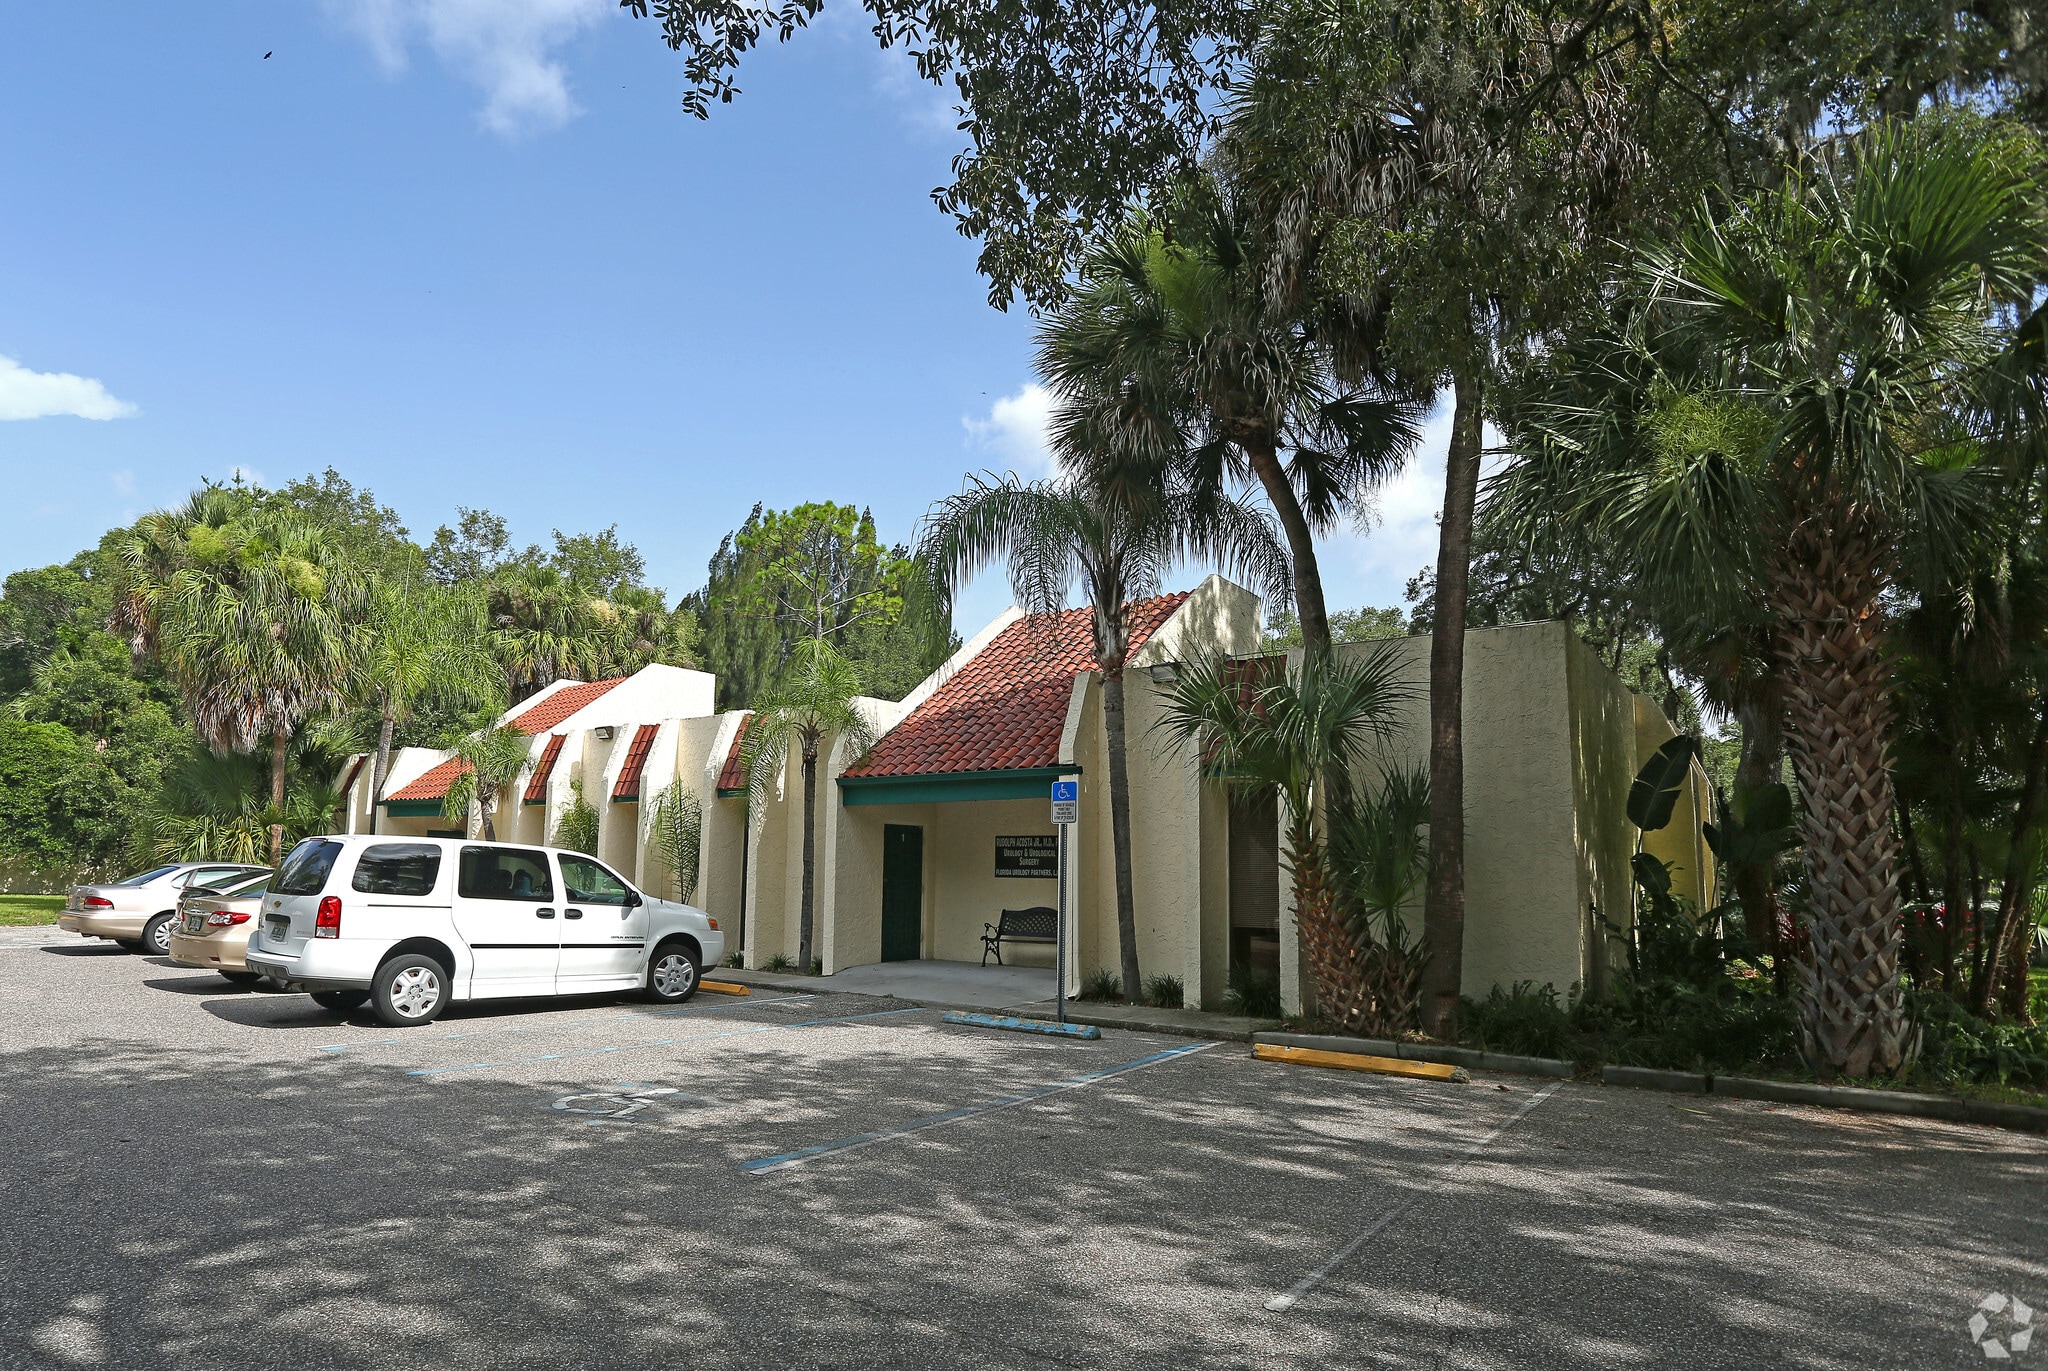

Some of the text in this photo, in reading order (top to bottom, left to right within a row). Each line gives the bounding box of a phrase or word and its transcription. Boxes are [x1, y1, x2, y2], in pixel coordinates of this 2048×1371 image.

[996, 837, 1016, 847] RUDOLPH
[1016, 837, 1033, 847] ACOSTA
[1003, 848, 1024, 857] UROLOGY
[1029, 848, 1056, 857] UROLOGICAL
[1019, 857, 1039, 866] SURGERY
